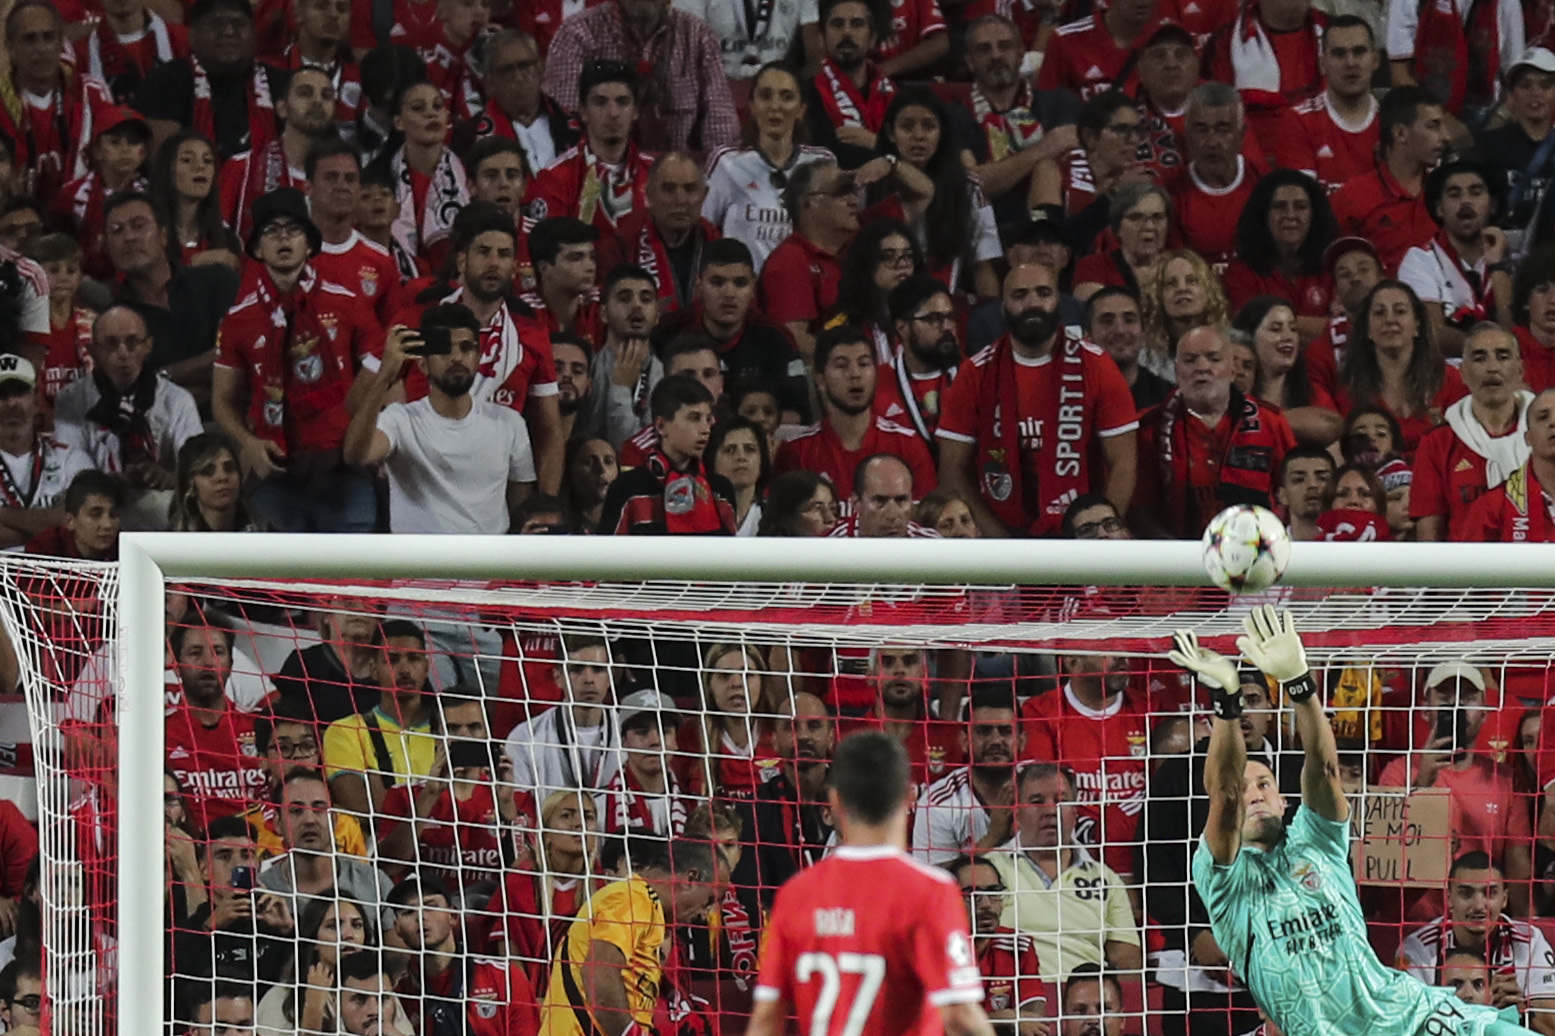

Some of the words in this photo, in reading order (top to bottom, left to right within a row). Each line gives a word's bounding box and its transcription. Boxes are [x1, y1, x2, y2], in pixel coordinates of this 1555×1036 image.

[1055, 386, 1094, 477] SPORT
[172, 768, 266, 788] Emirates
[1067, 768, 1146, 790] mirates
[1366, 855, 1416, 882] PULL
